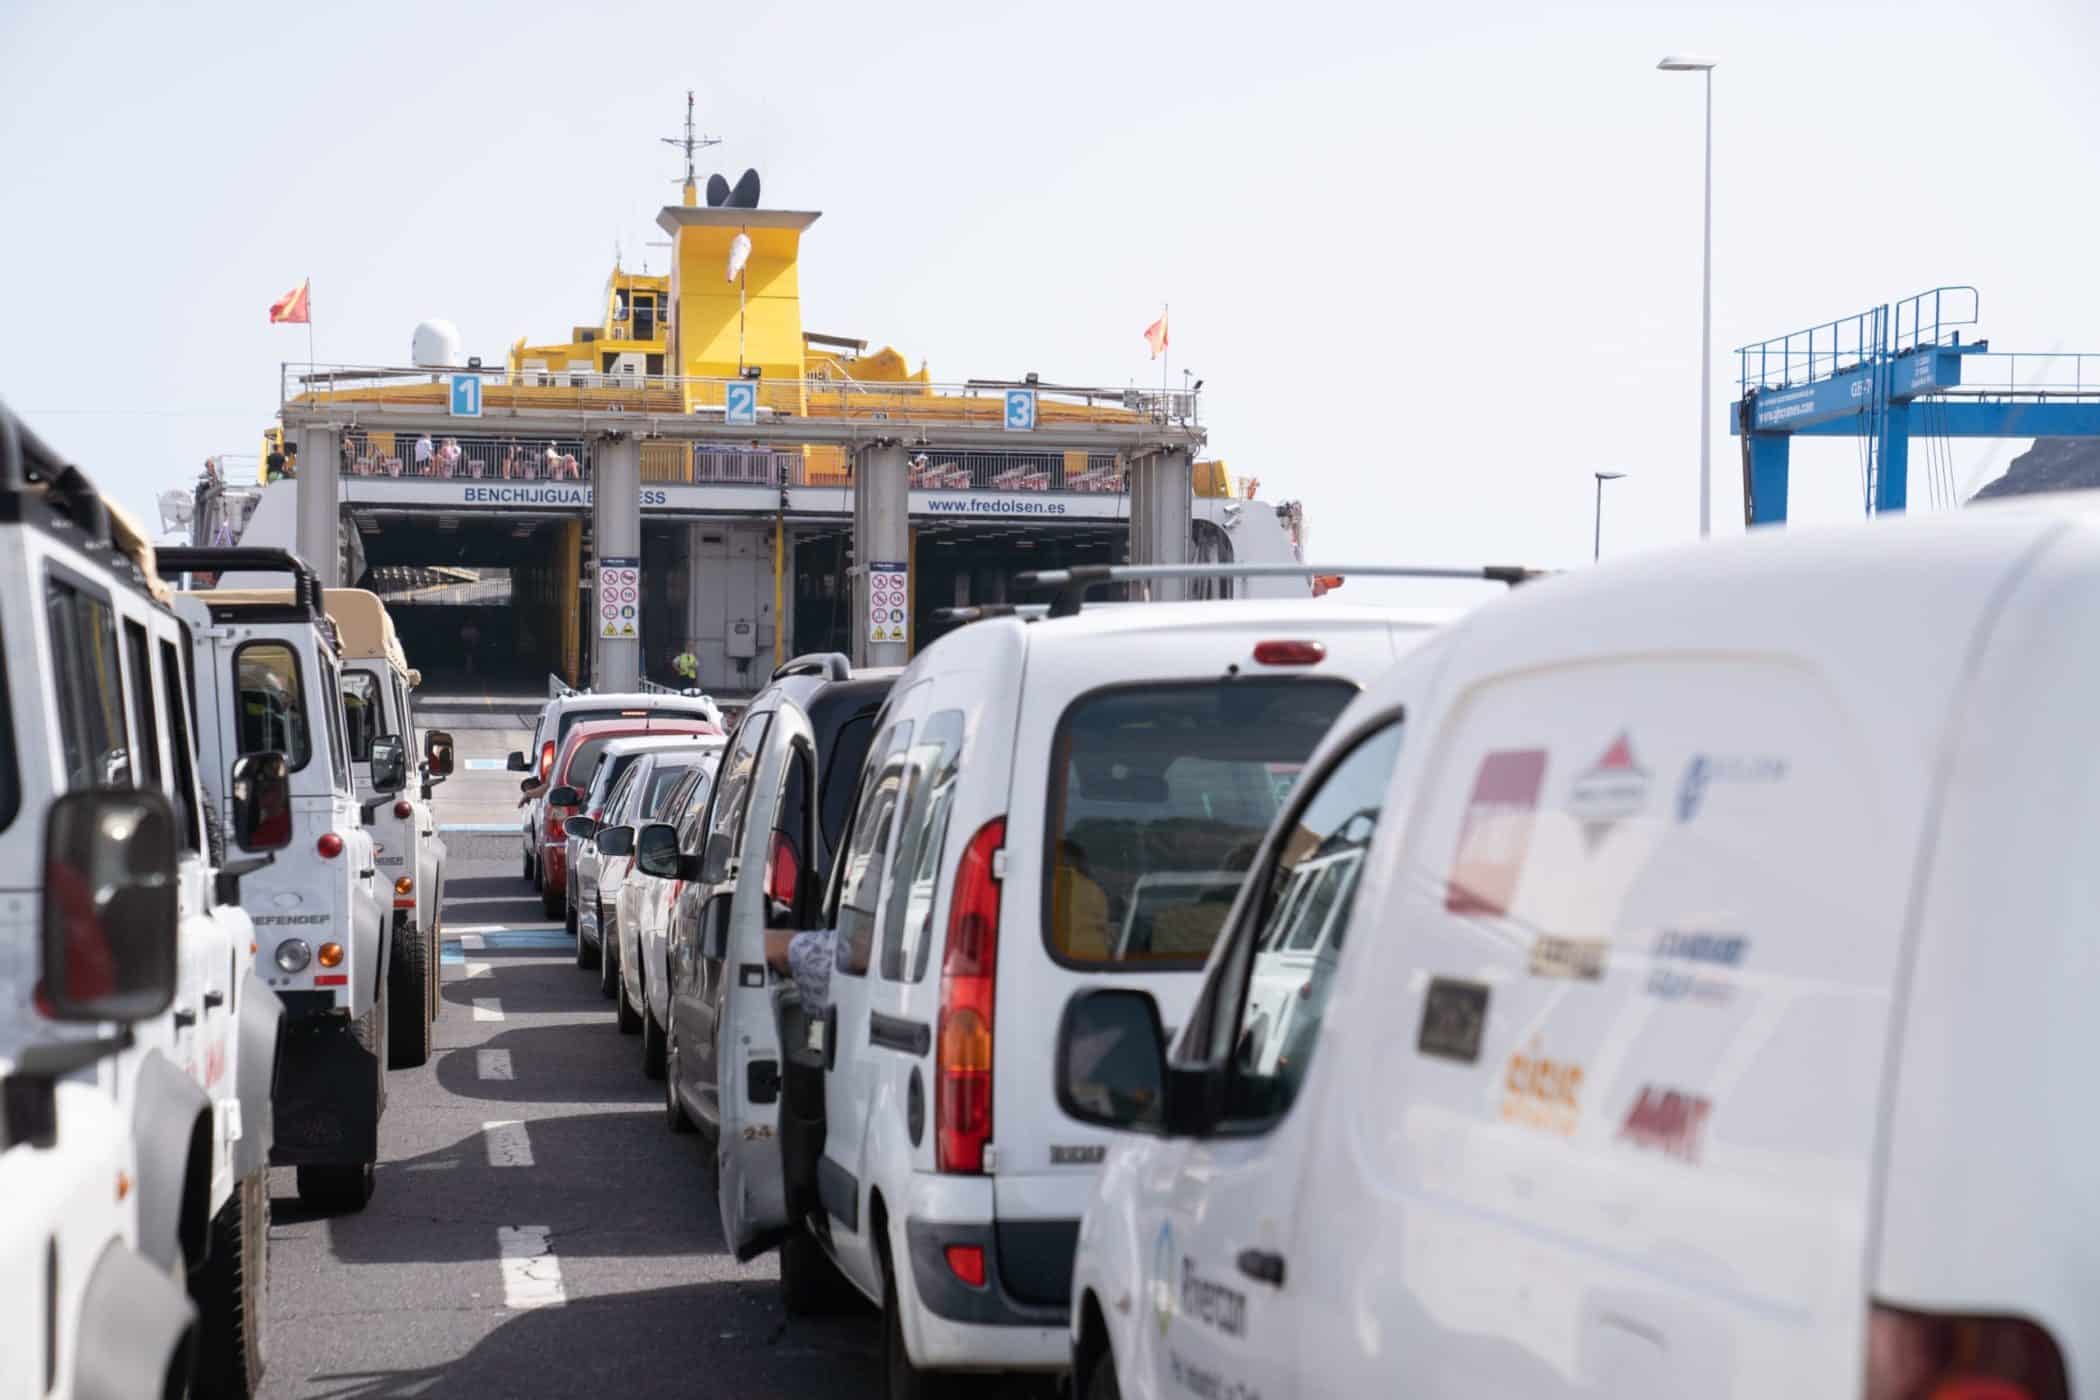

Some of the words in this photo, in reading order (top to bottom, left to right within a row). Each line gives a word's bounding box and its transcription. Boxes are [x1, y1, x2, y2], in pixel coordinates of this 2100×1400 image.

[459, 379, 474, 411] 1
[731, 387, 751, 420] 2
[1009, 395, 1030, 427] 3
[464, 488, 581, 504] BENCHIJIGUA
[928, 498, 1066, 514] www.fredolsen.es
